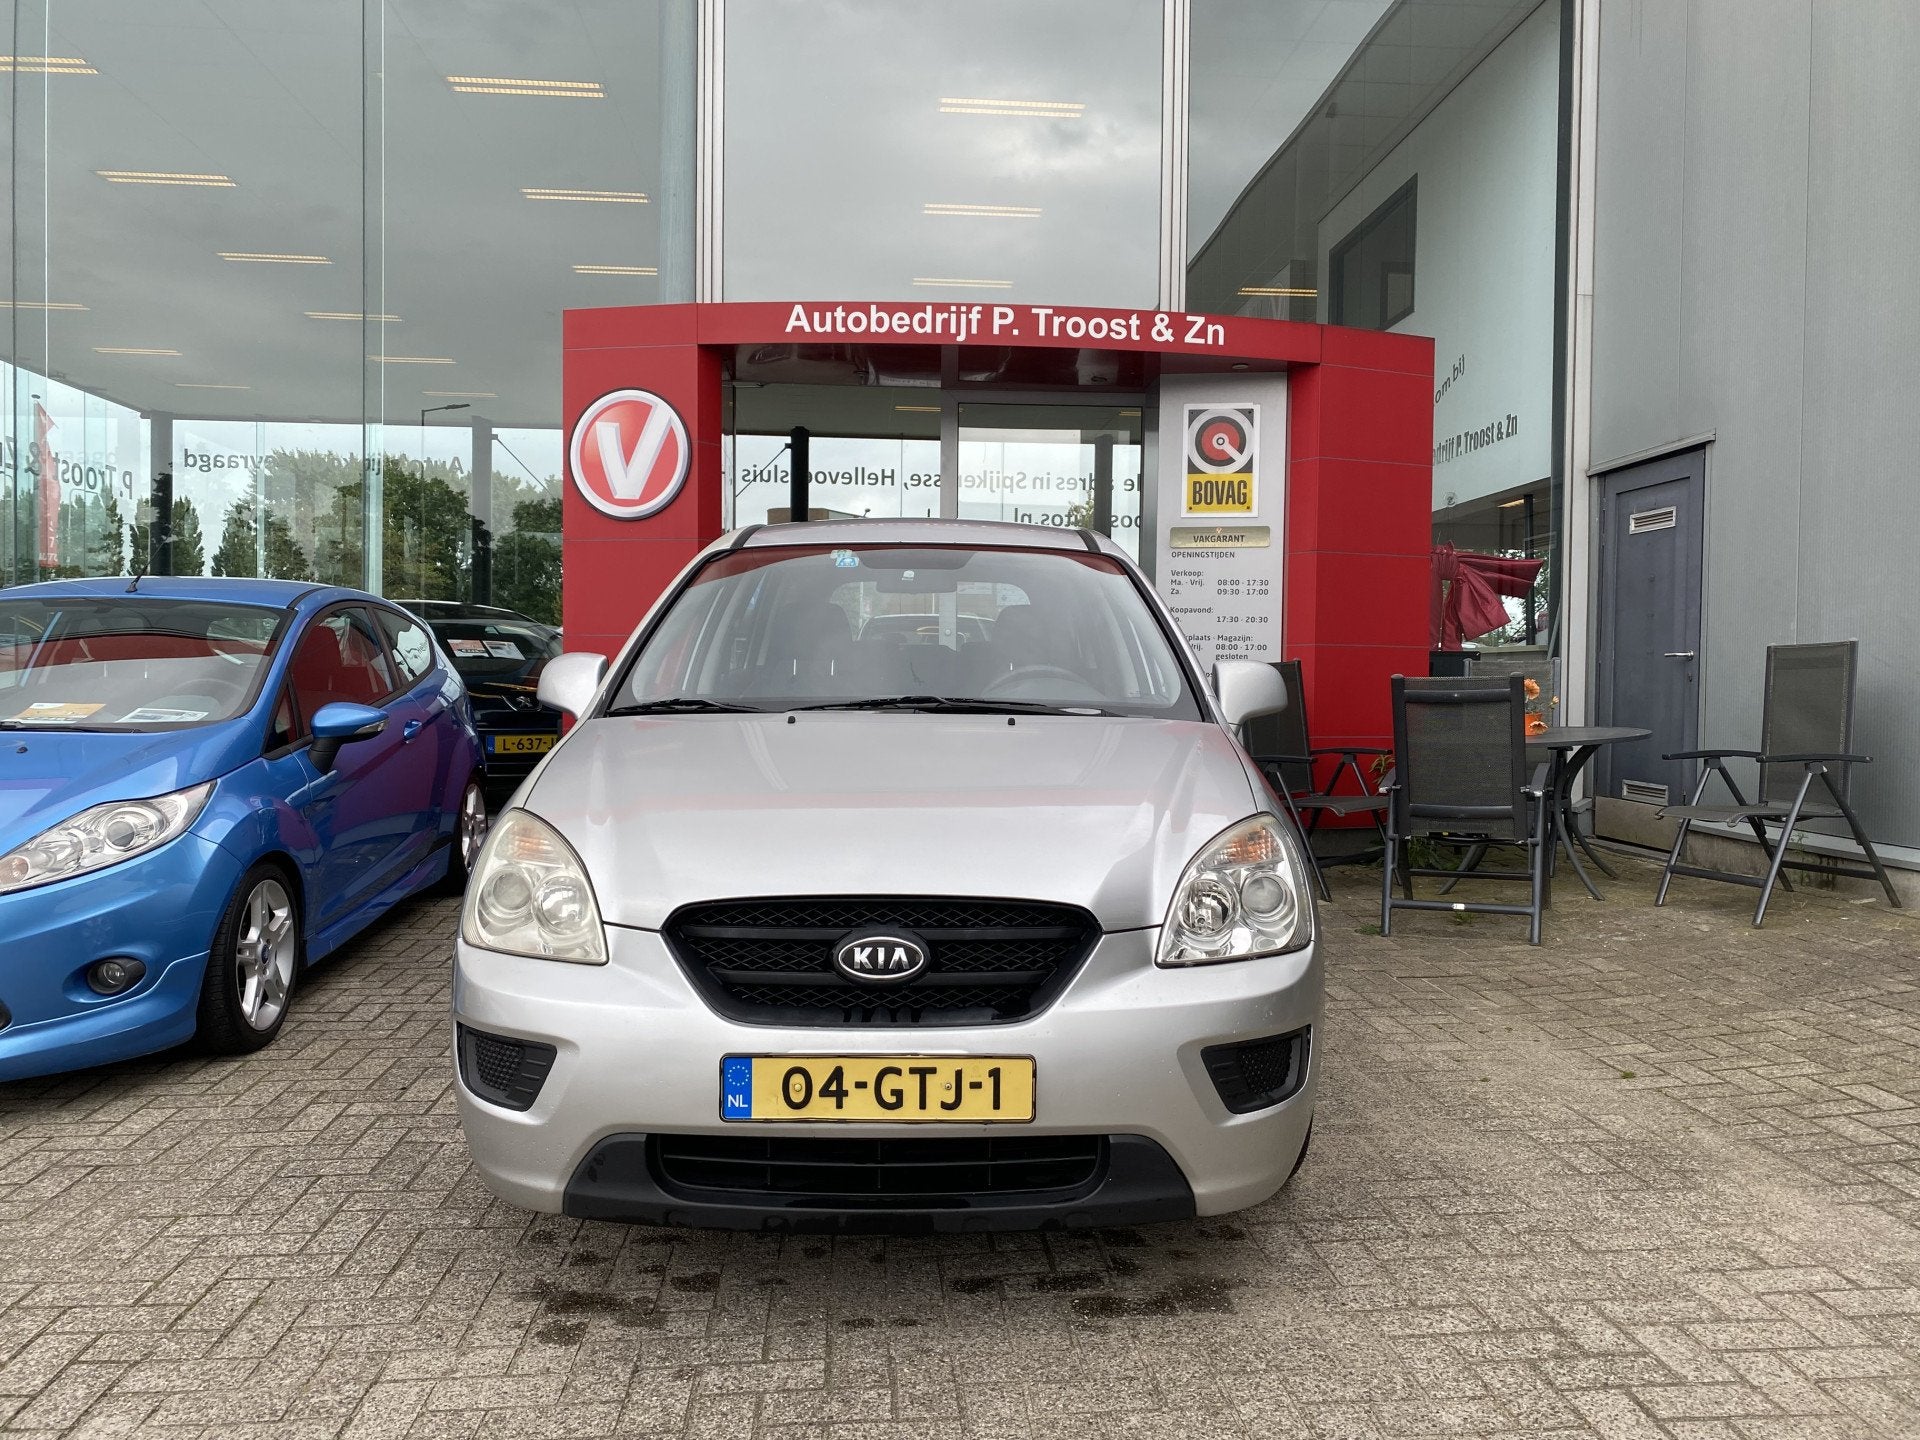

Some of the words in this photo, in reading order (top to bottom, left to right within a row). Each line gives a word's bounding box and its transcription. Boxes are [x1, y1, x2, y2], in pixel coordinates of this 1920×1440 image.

[785, 304, 982, 342] Autobedrijf
[992, 306, 1019, 336] P.
[1031, 308, 1141, 341] Troost
[1150, 313, 1175, 343] &
[1184, 315, 1225, 346] Zn
[1453, 354, 1465, 382] bij
[1456, 434, 1463, 457] P.
[1464, 422, 1495, 455] Troost
[1497, 421, 1504, 442] &
[1506, 413, 1518, 438] Zn
[1192, 480, 1248, 505] BOVAG
[1193, 534, 1245, 543] VAKGARANT
[1171, 551, 1235, 559] OPENINGSTIJDEN
[1171, 569, 1204, 577] Verkoop:
[1190, 579, 1205, 587] Vrij.
[1217, 579, 1240, 587] 08:00
[1247, 579, 1270, 587] 17:30
[1217, 588, 1240, 596] 09:30
[1246, 588, 1269, 596] 17:00
[1170, 606, 1214, 614] Koopavond:
[1245, 616, 1269, 624] 20:30
[1217, 634, 1254, 643] Magazijn:
[1215, 643, 1239, 651] 08:00
[853, 947, 911, 970] KIA
[727, 1094, 749, 1108] NL
[781, 1065, 1001, 1111] 04-GTJ-1
